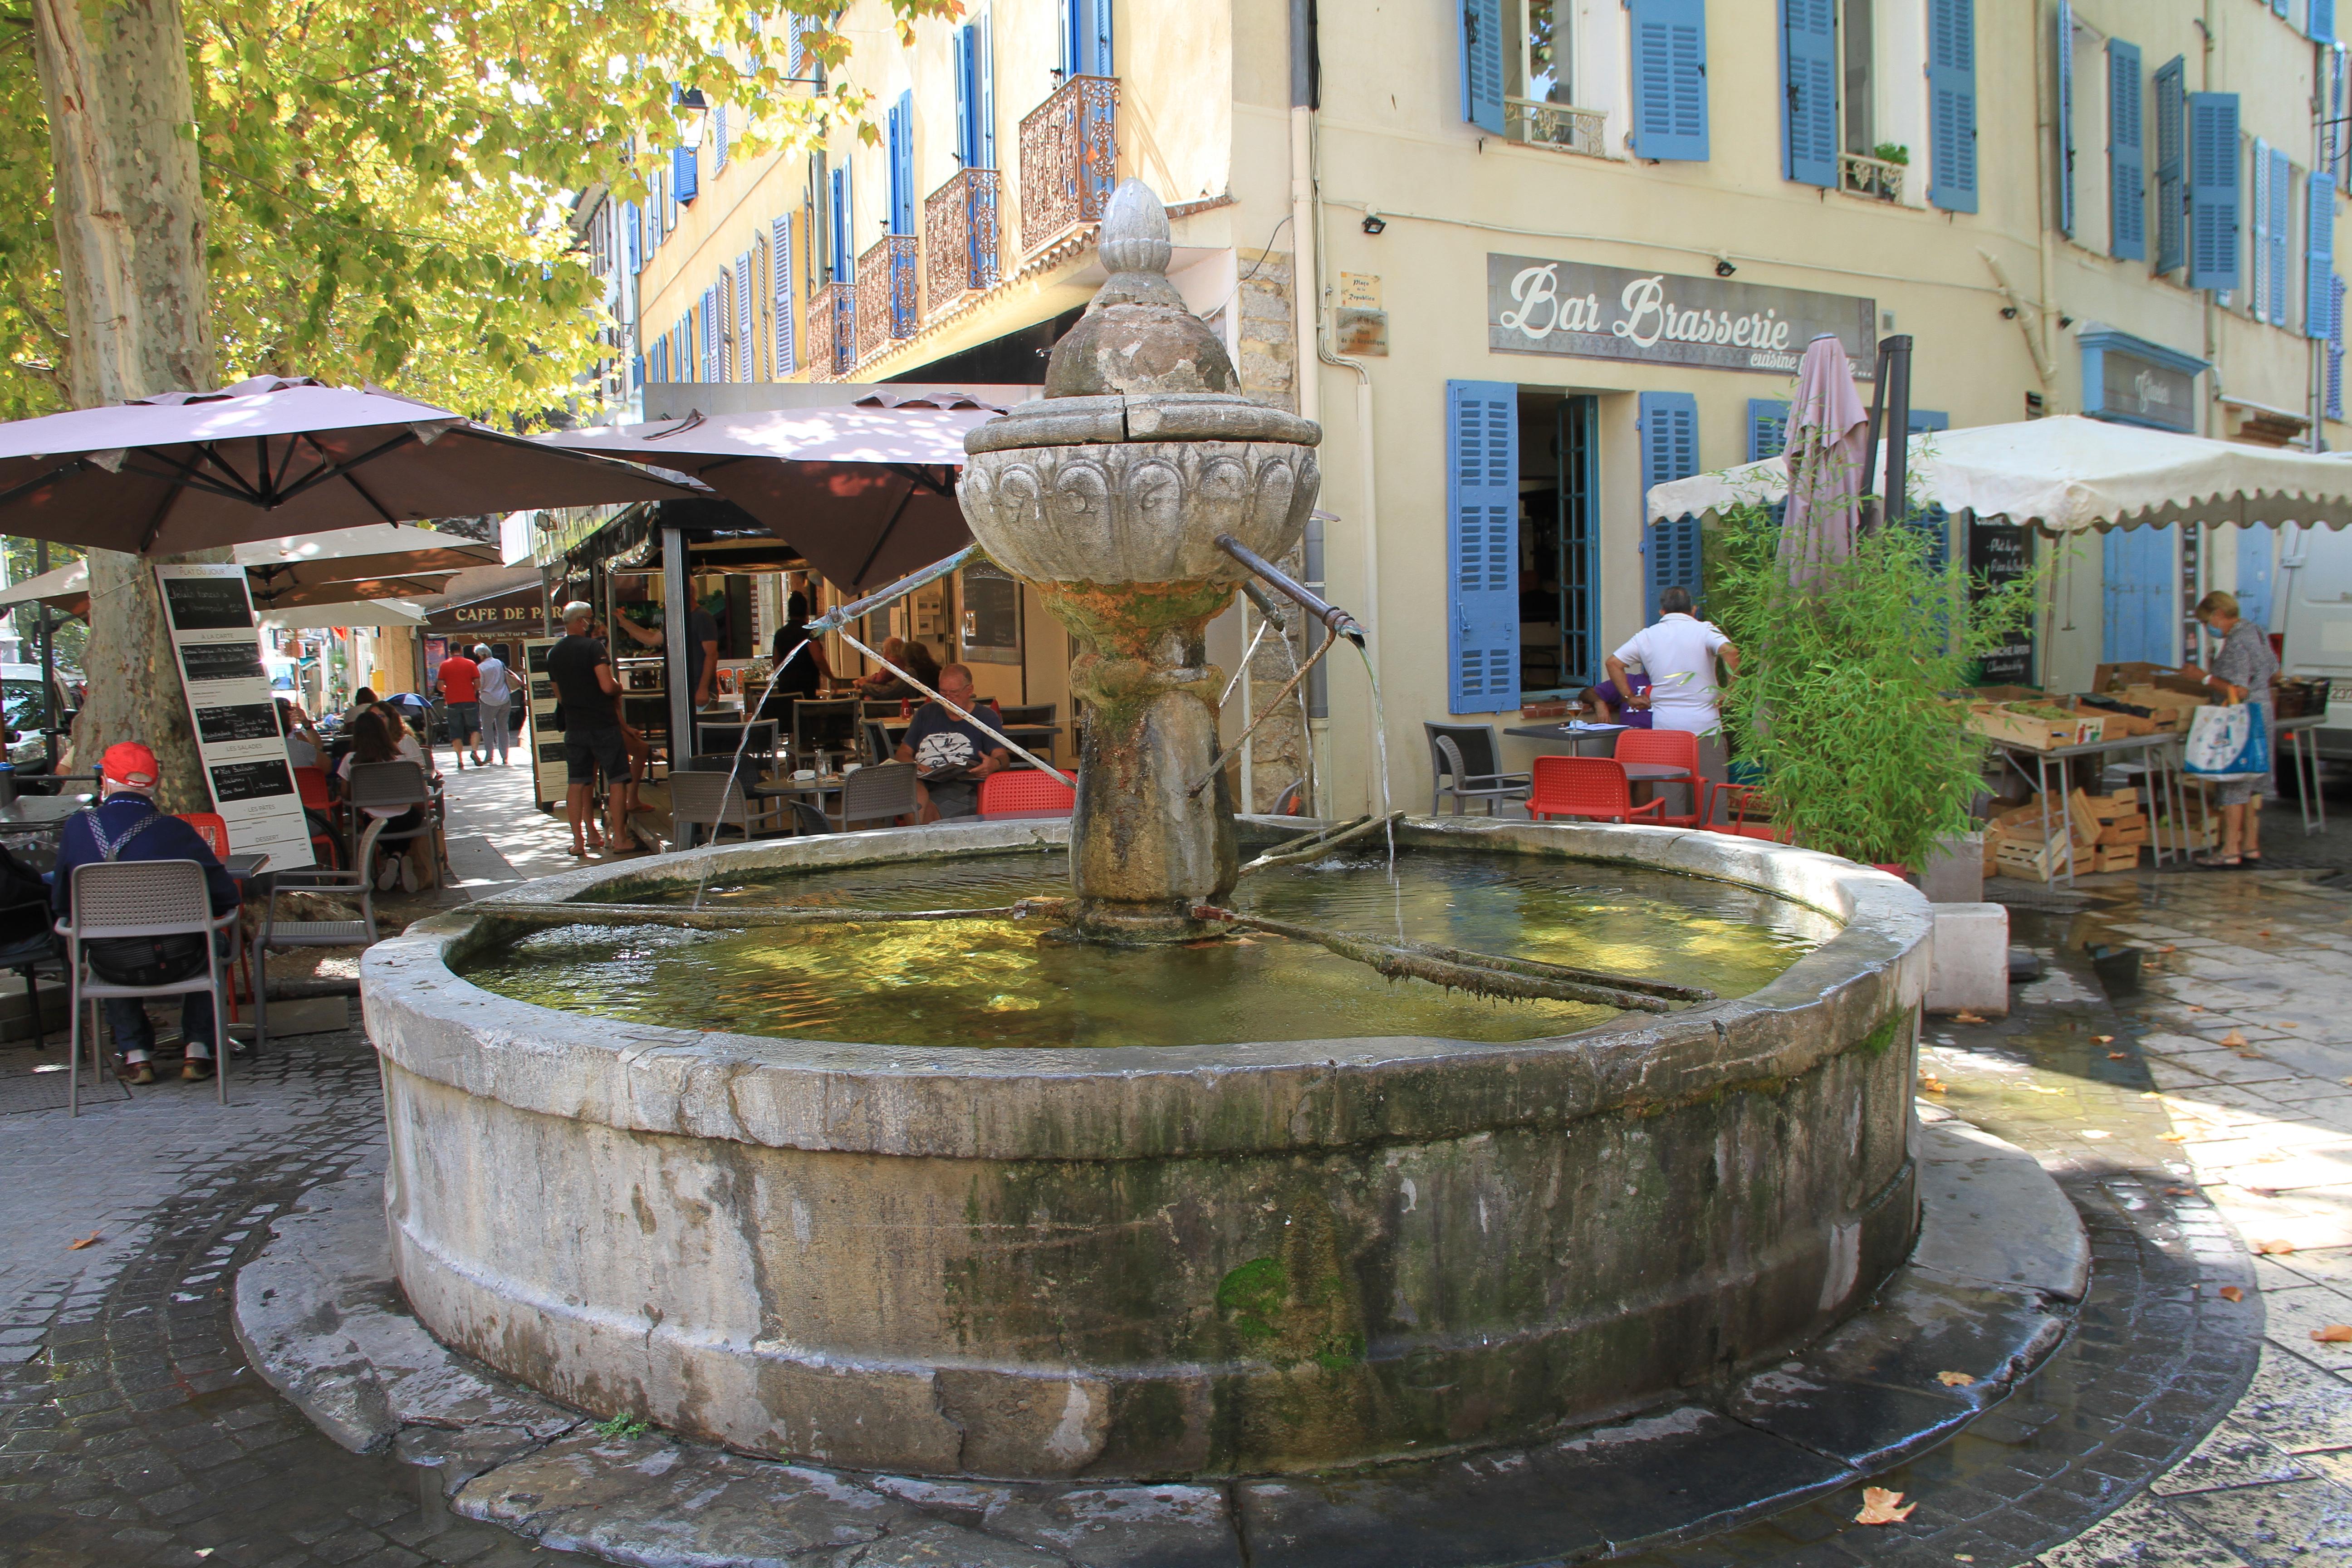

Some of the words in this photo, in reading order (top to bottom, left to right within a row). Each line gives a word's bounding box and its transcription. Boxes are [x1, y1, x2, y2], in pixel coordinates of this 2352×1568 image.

[1500, 263, 1601, 339] Bar
[1612, 275, 1789, 350] Brasserie
[1750, 351, 1797, 369] cuisine
[456, 607, 498, 622] CAFE
[504, 607, 525, 620] DE
